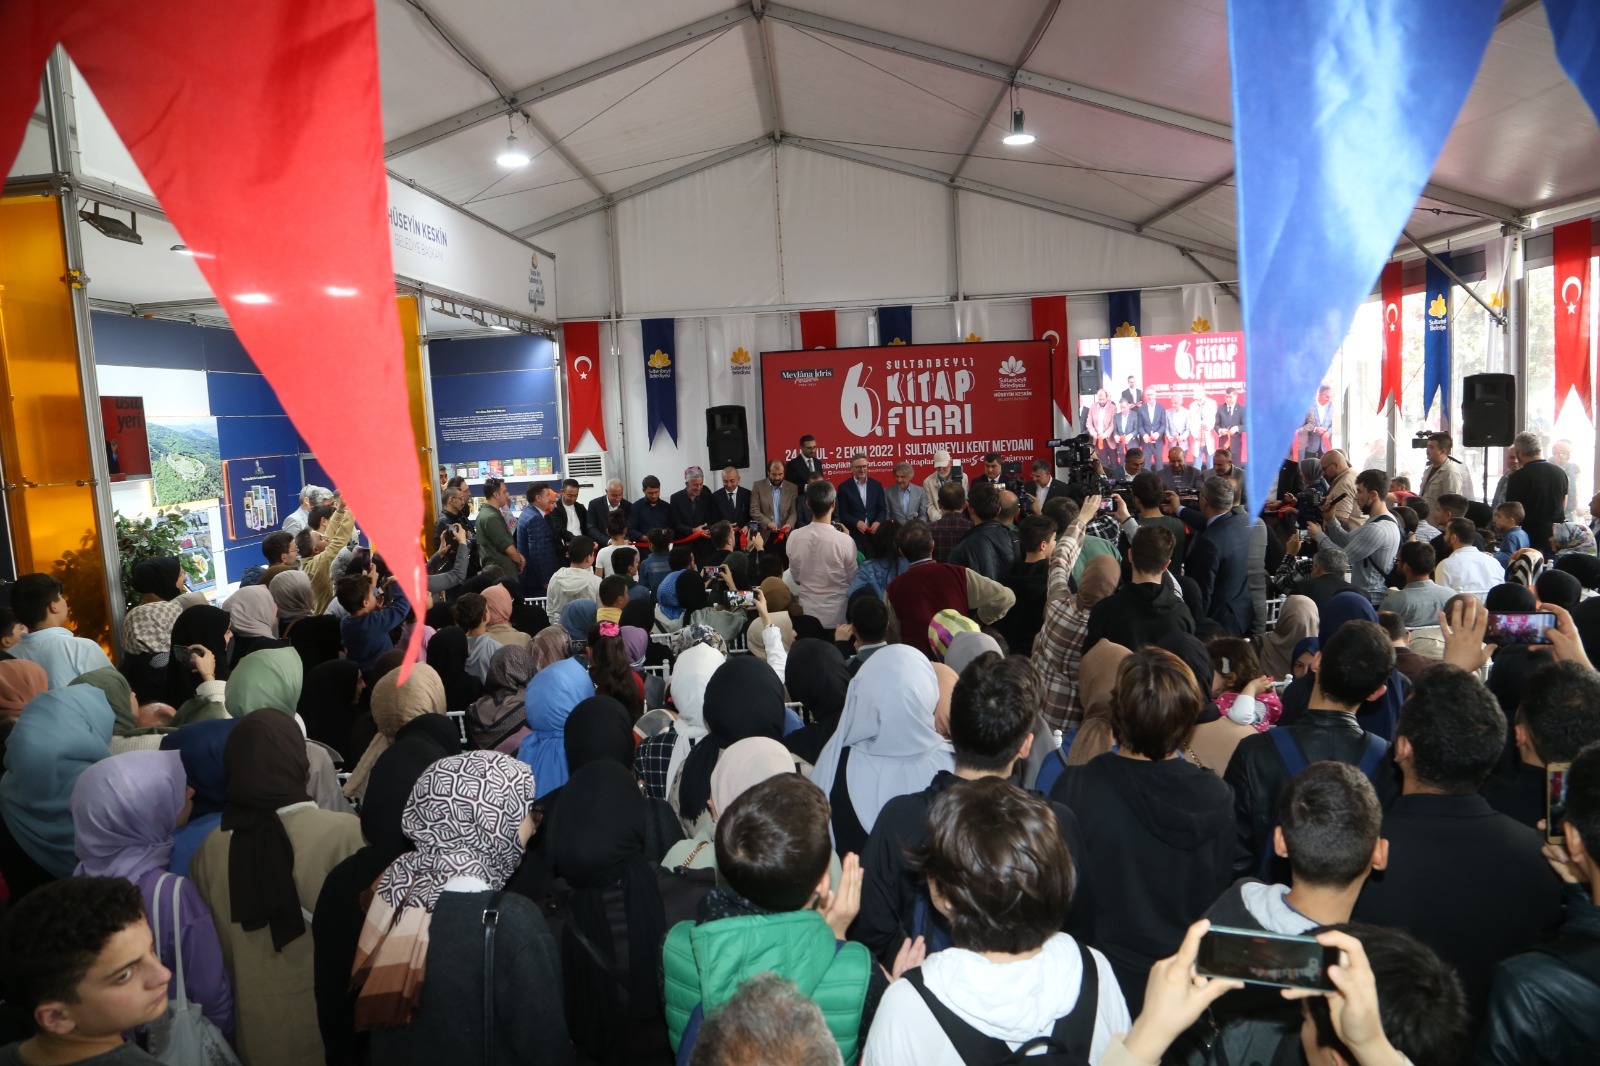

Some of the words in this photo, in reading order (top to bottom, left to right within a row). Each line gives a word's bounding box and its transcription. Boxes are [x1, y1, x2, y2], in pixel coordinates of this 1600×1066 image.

[421, 223, 448, 247] KESKİN
[886, 369, 976, 404] KİTAP
[117, 411, 142, 433] yeri
[887, 403, 973, 438] FUARI
[785, 449, 798, 462] 24
[835, 446, 843, 459] 2
[869, 444, 894, 458] 2022
[905, 441, 965, 456] SULTANBEYLİ
[966, 440, 991, 453] KENT
[992, 438, 1034, 452] MEYDANI
